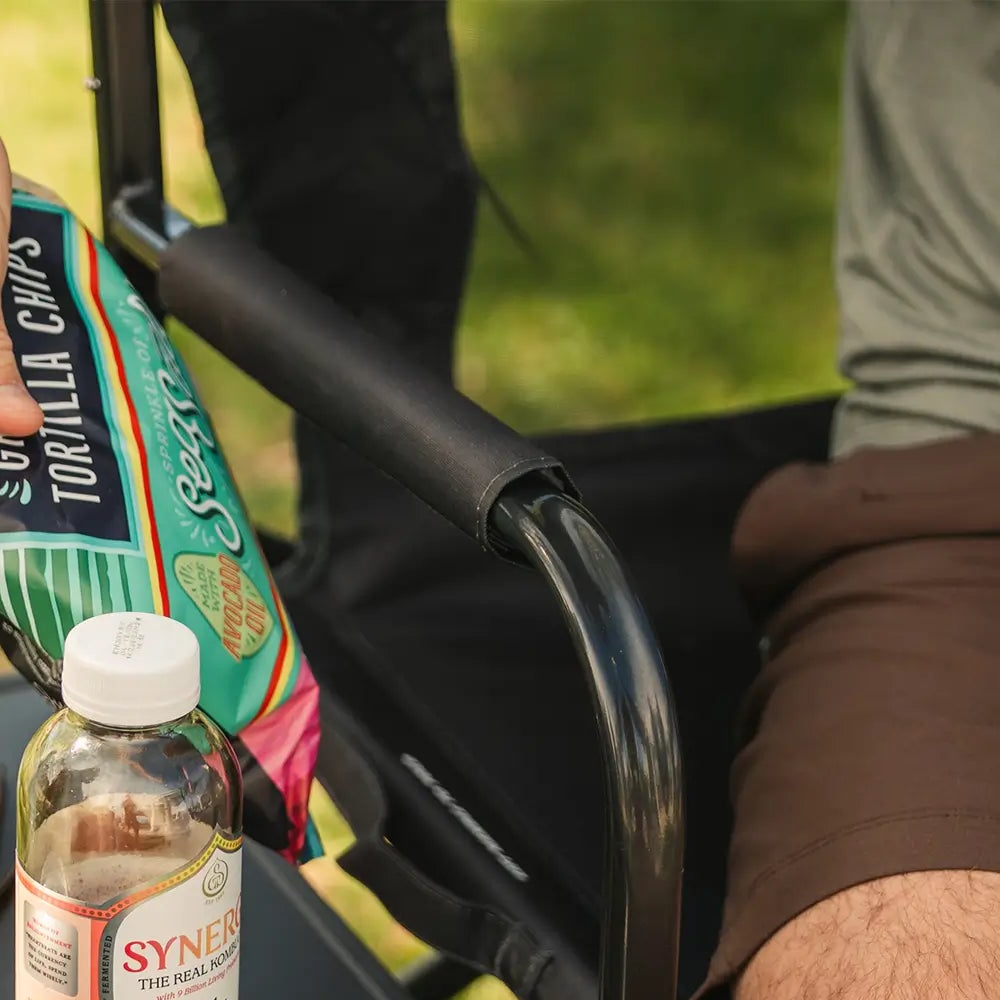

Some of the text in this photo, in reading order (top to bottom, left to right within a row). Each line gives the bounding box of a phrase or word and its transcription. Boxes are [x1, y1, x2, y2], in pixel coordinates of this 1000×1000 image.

[7, 236, 101, 503] TORTILLA CHIPS
[218, 552, 243, 661] AVOCADO
[101, 935, 113, 994] FERMENTED
[138, 975, 170, 990] THE
[173, 964, 208, 985] REAL
[177, 989, 183, 998] 9
[184, 979, 207, 996] Billion
[208, 968, 227, 988] Living
